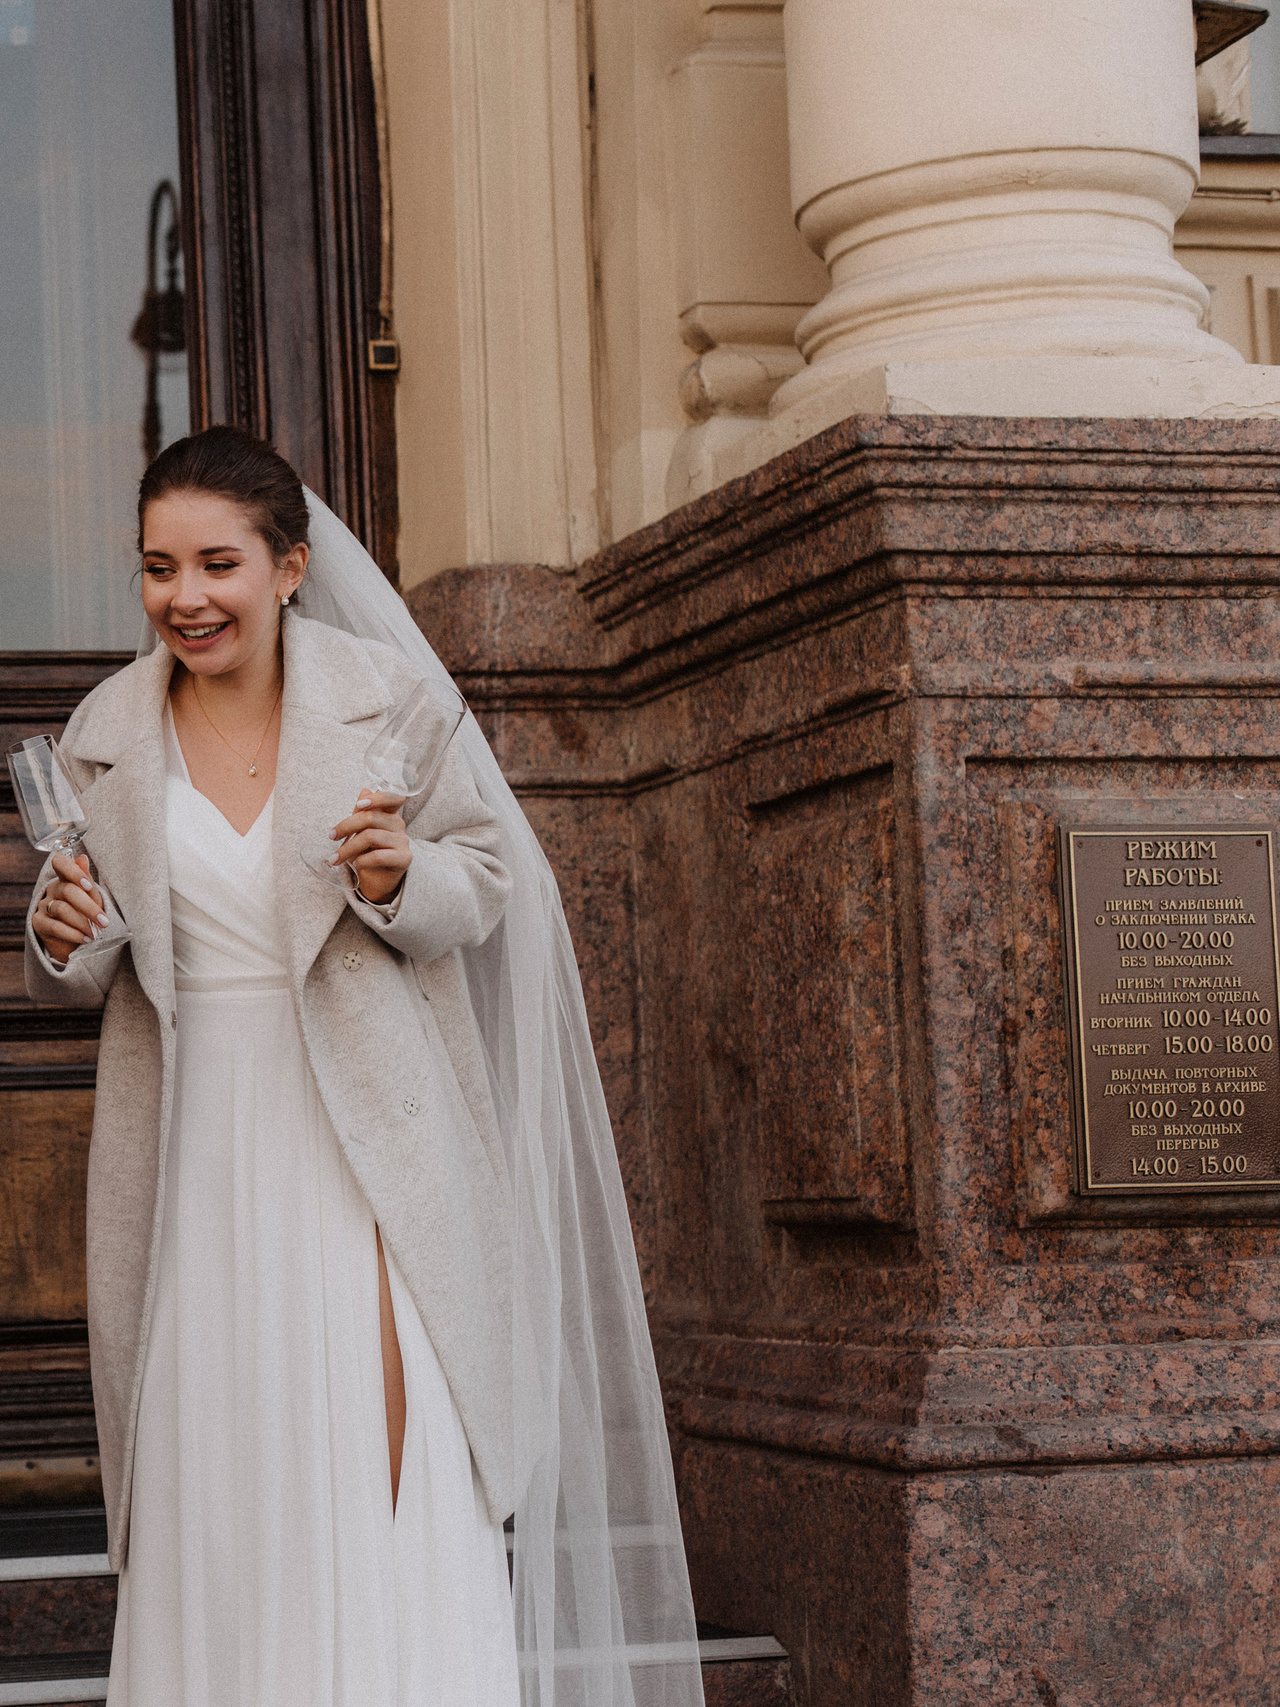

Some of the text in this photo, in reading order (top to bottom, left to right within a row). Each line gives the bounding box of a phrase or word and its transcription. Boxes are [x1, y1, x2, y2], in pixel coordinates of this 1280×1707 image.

[1126, 841, 1217, 860] РЕЖИМ
[1124, 868, 1223, 886] РАБОТЫ:
[1105, 897, 1244, 911] ПРИЕМ ЗАЯВЛЕНИЙ
[1095, 913, 1256, 926] О ЗАКЛЮЧЕНИИ БРАКА
[1121, 955, 1233, 967] БЕЗ ВЫХОДНЫХ
[1117, 977, 1242, 989] ПРИЕМ ГРАЖДАН
[1100, 991, 1260, 1004] НАЧАЛЬНИКОМ ОТДЕЛА
[1091, 1017, 1153, 1029] ВТОРНИК
[1092, 1044, 1150, 1055] ЧЕТВЕРГ
[1111, 1067, 1258, 1081] ВЫДАЧА ПОВТОРНЫХ
[1104, 1082, 1266, 1096] ДОКУМЕНТОВ В АРХИВЕ
[1132, 1123, 1243, 1136] БЕЗ ВЫХОДНЫХ
[1156, 1139, 1219, 1151] ПЕРЕРЫВ
